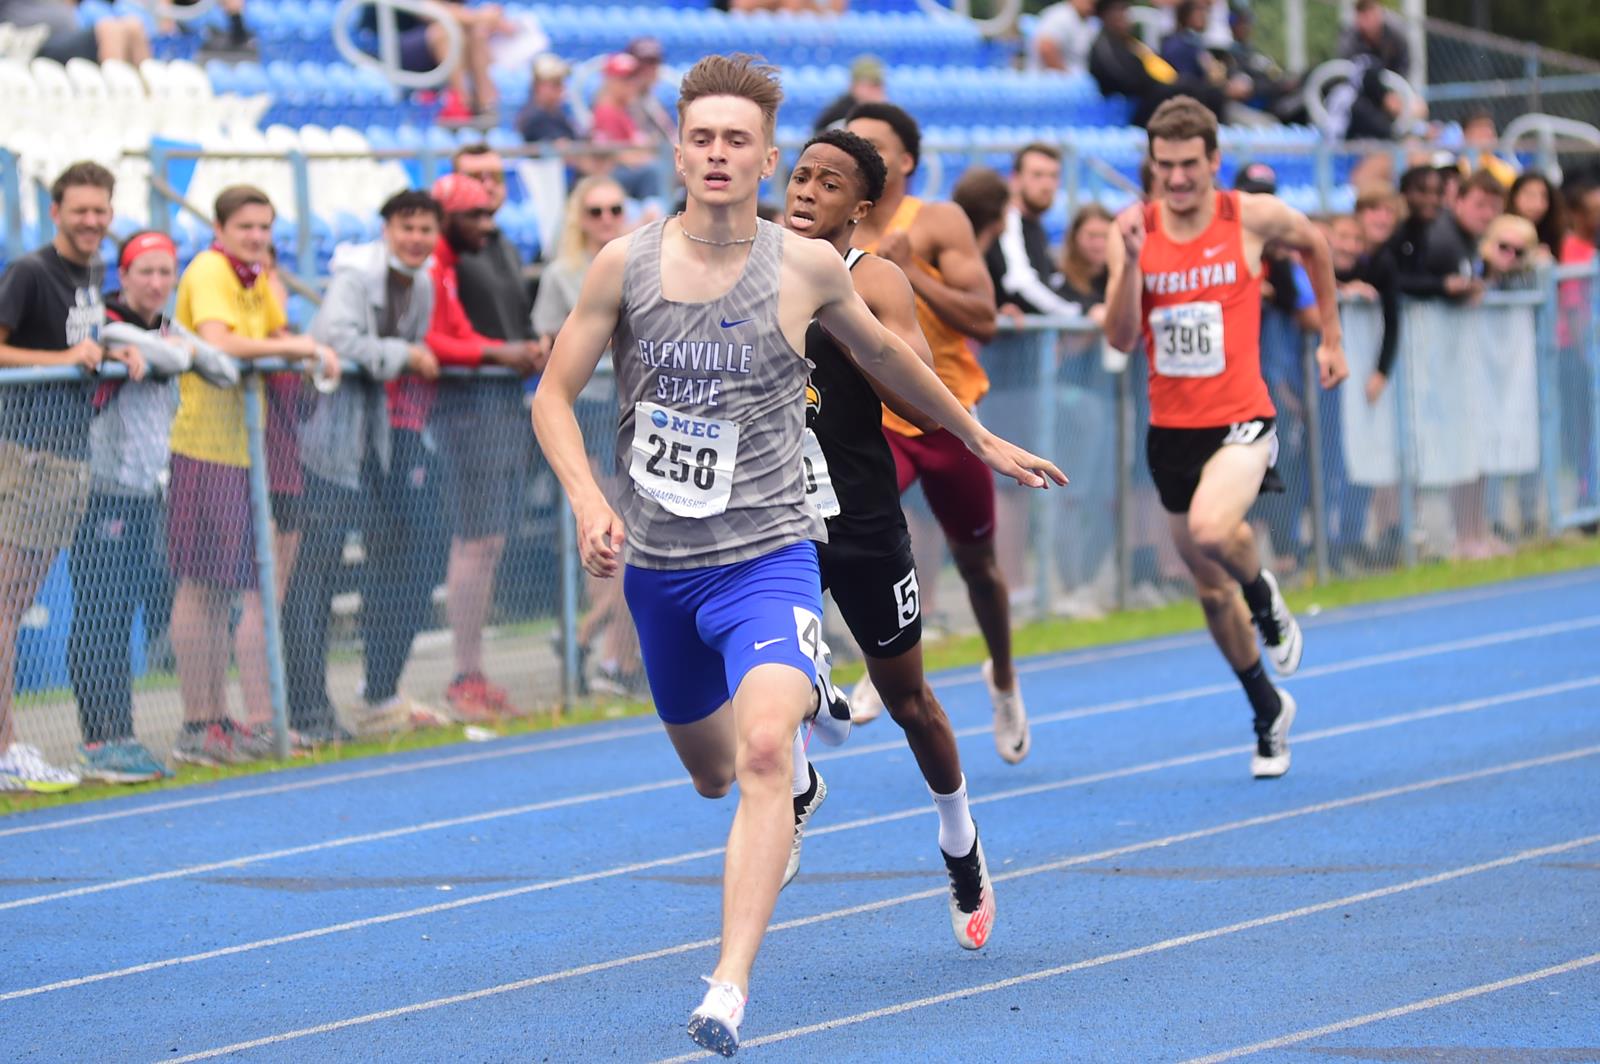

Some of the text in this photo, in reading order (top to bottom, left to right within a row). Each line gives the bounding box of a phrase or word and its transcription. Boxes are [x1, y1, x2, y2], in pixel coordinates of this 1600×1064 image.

[1143, 260, 1238, 295] WESLEYAN
[637, 338, 753, 374] GLENVILLE
[1163, 322, 1211, 356] 396
[655, 374, 722, 407] STATE
[671, 415, 721, 440] MEC
[645, 433, 719, 491] 258
[900, 574, 920, 622] 5
[801, 617, 821, 660] 4
